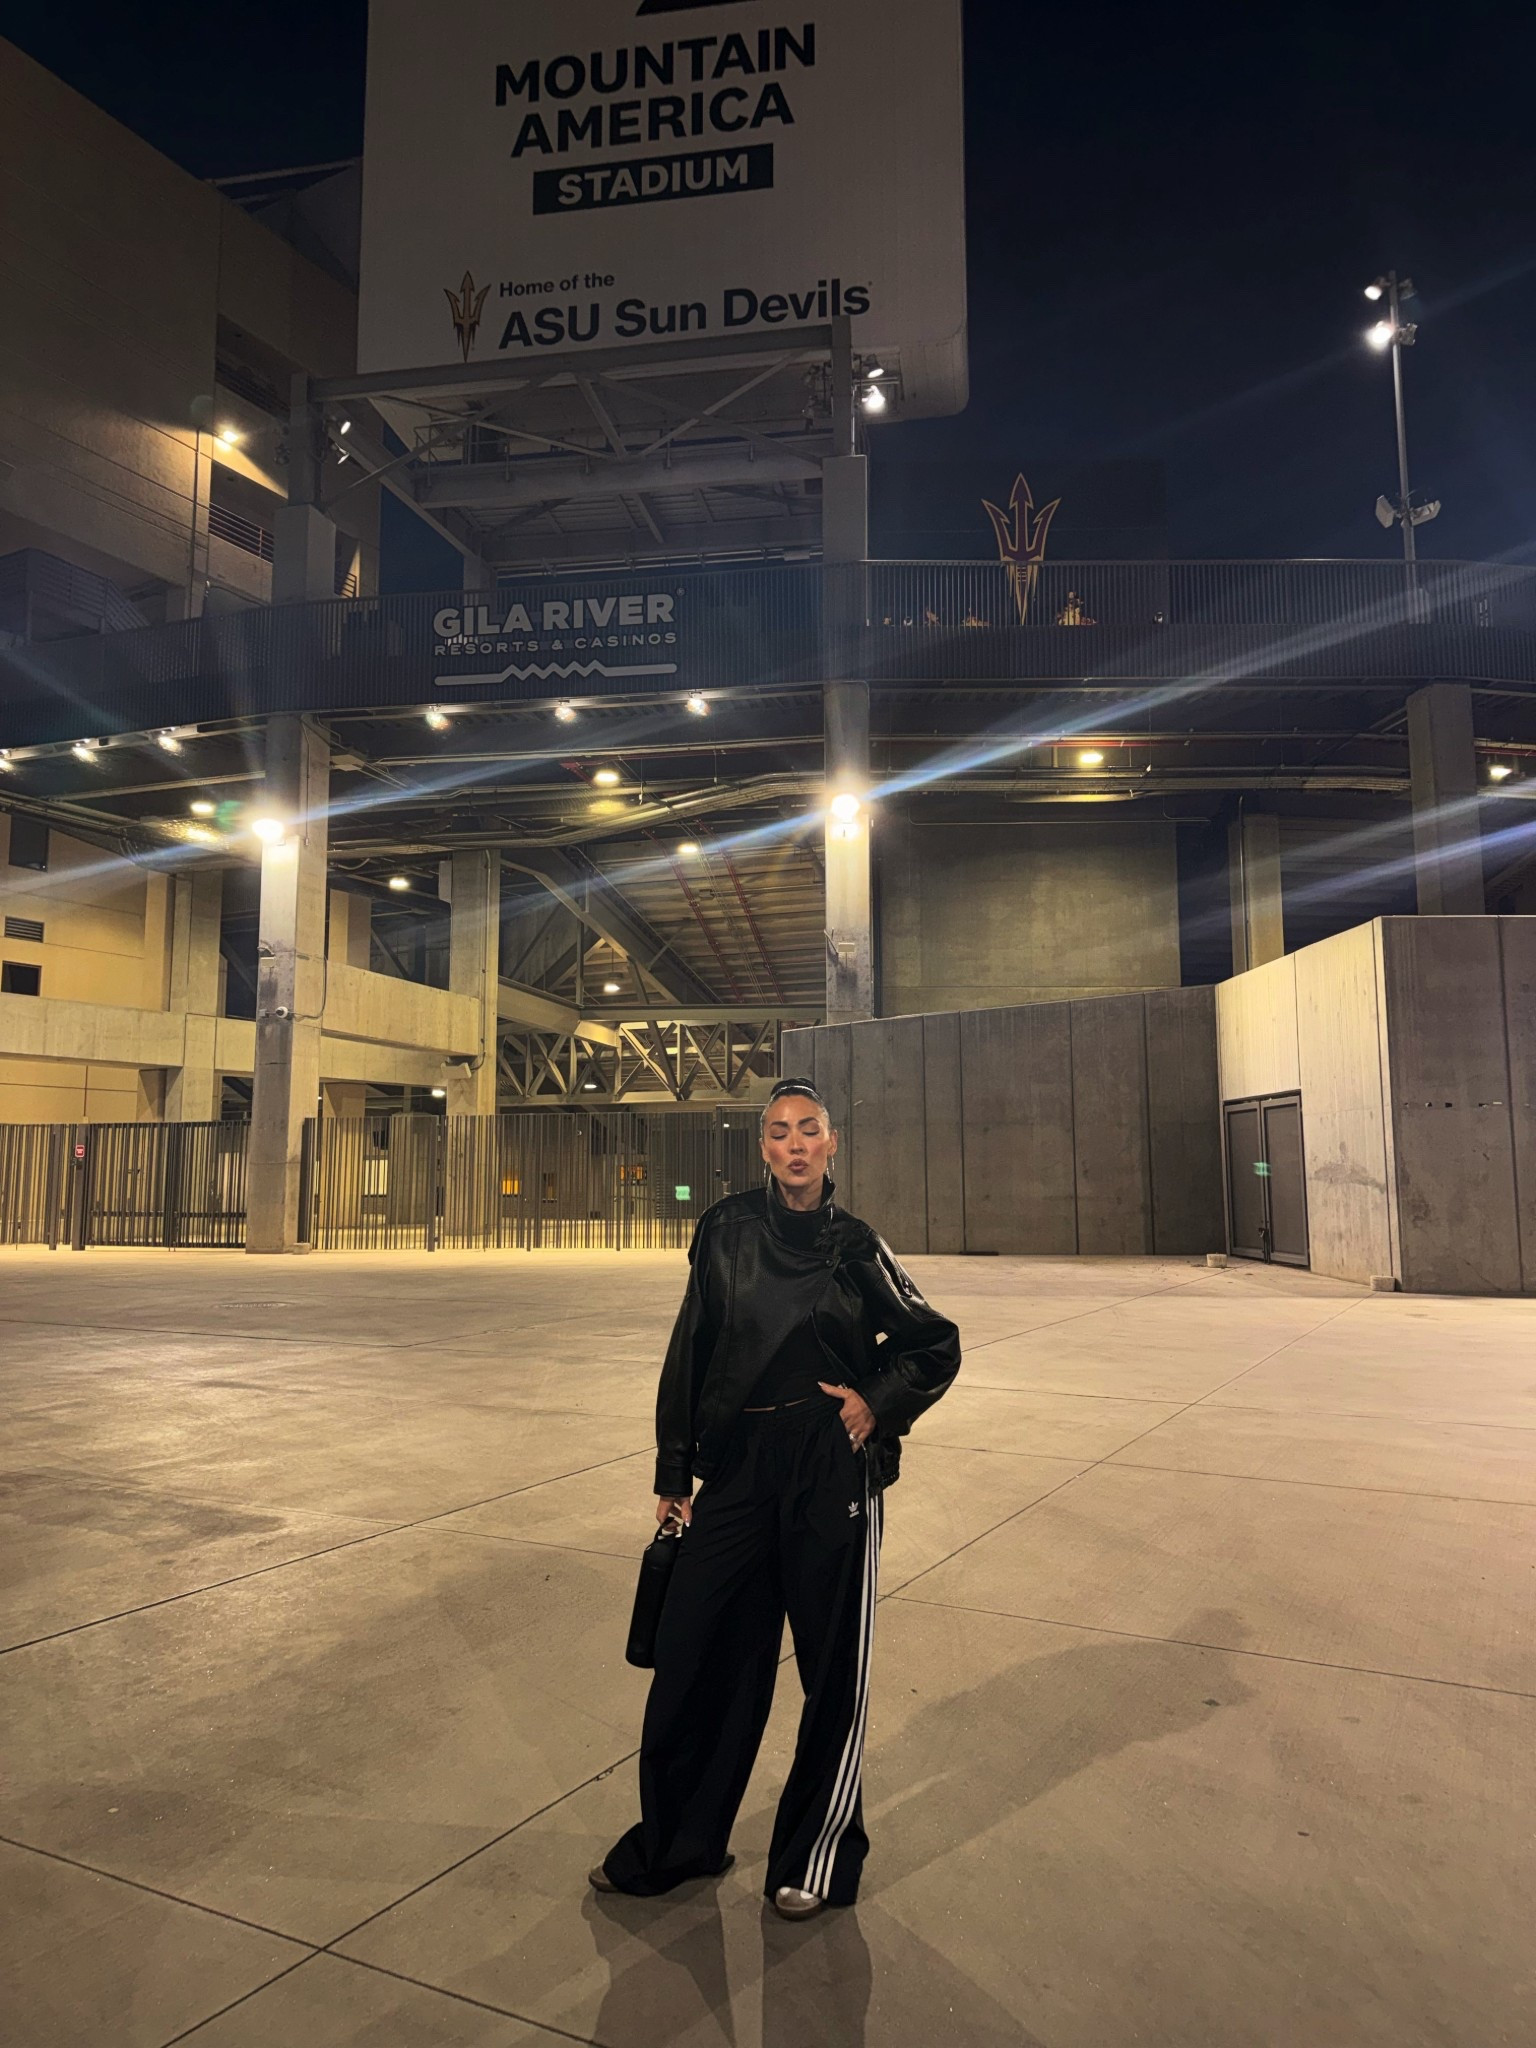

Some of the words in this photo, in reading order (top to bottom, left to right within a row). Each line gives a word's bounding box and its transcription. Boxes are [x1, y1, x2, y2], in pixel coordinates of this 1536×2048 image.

[495, 23, 815, 107] MOUNTAIN
[510, 82, 795, 158] AMERICA
[557, 153, 749, 205] STADIUM
[500, 281, 554, 297] Home
[559, 274, 579, 291] of
[584, 272, 615, 289] the
[499, 303, 600, 350] ASU
[615, 298, 707, 338] Sun
[724, 278, 870, 327] Devils
[433, 605, 533, 638] GILA
[543, 593, 675, 631] RIVER
[434, 640, 540, 656] RESORTS
[551, 639, 564, 650] &
[574, 632, 678, 649] CASINOS
